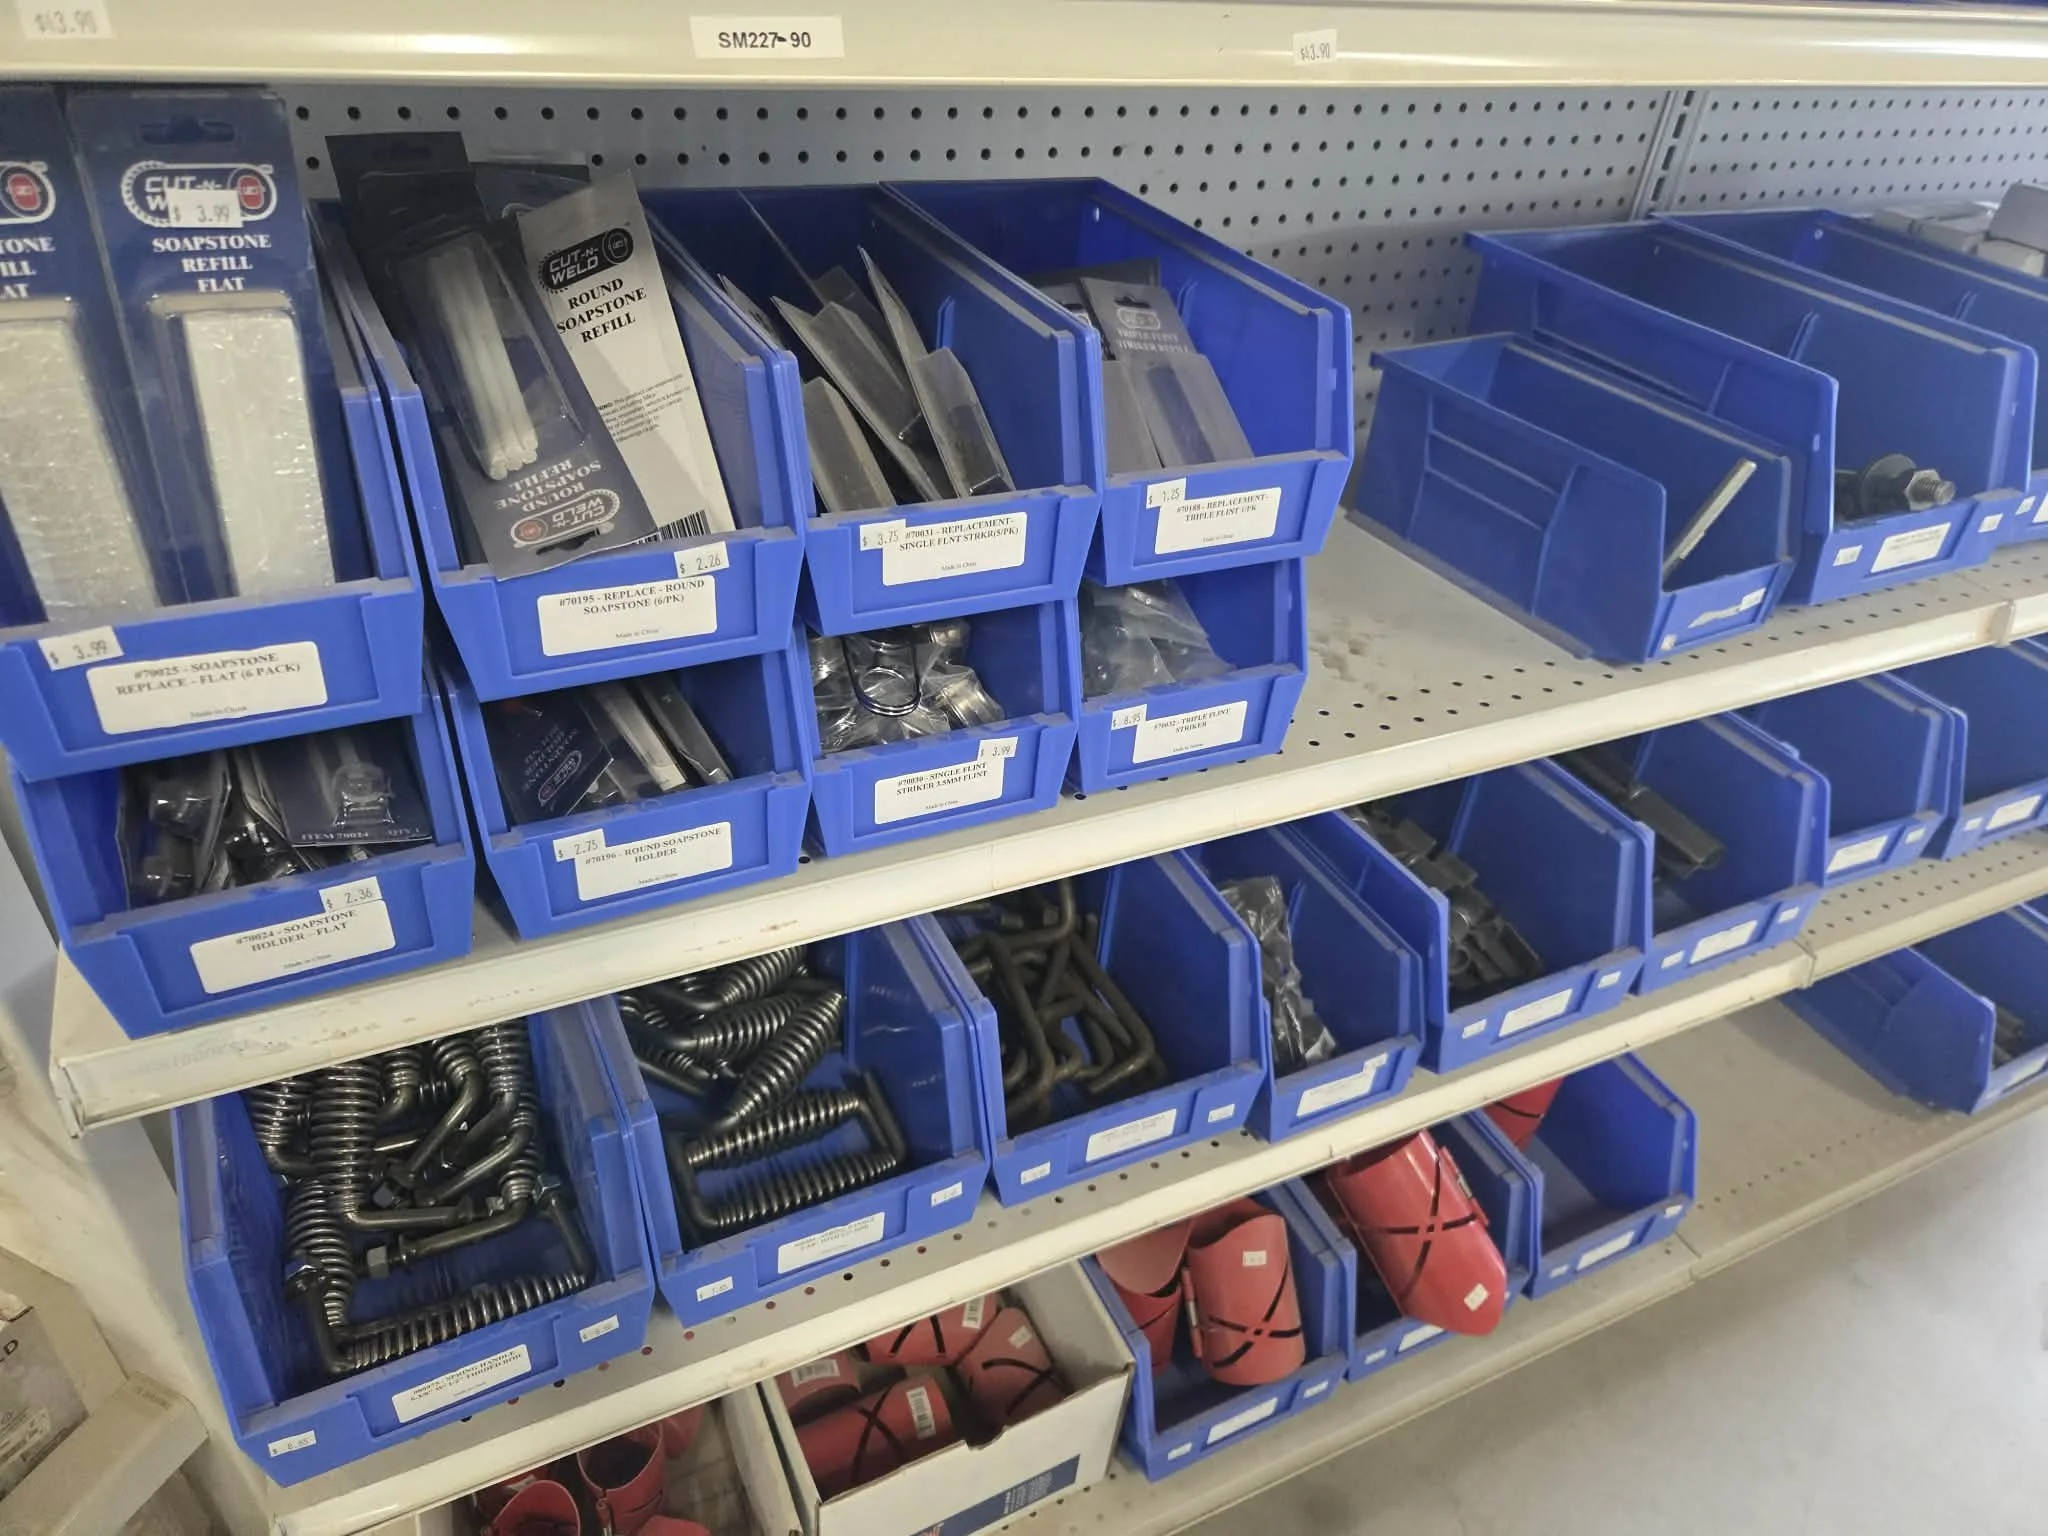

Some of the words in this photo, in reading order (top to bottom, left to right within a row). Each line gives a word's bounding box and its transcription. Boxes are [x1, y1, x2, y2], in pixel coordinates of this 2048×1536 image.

[198, 204, 230, 223] 3.99
[152, 234, 272, 253] SOAPSTONE
[182, 255, 253, 273] REFILL
[551, 256, 599, 286] WELD
[197, 276, 245, 293] FLAT
[568, 278, 624, 309] ROUND
[556, 287, 647, 334] SOAPSTONE
[580, 312, 636, 344] REFILL
[496, 459, 602, 511] SOAPSTONE
[509, 459, 573, 492] REFILL
[522, 482, 585, 513] ROUND
[551, 496, 604, 522] WELD
[899, 540, 935, 552] SINGLE
[696, 552, 721, 571] 2.26
[559, 595, 595, 607] #70195
[604, 586, 656, 602] REPLACE
[666, 579, 706, 594] ROUND
[583, 598, 651, 615] SOAPSTONE
[72, 639, 108, 661] 3.99
[191, 652, 279, 673] SOAPSTONE
[116, 678, 192, 697] REPLACE
[199, 671, 237, 687] FLAT
[252, 662, 301, 680] PACK)
[930, 768, 961, 781] SINGLE
[896, 783, 935, 796] STRIKER
[574, 838, 599, 856] 2.75
[624, 842, 661, 856] ROUND
[662, 827, 722, 848] SOAPSTONE
[634, 847, 678, 864] HOLDER
[344, 887, 373, 905] 2.36
[283, 910, 356, 934] SOAPSTONE
[251, 934, 305, 952] HOLDER
